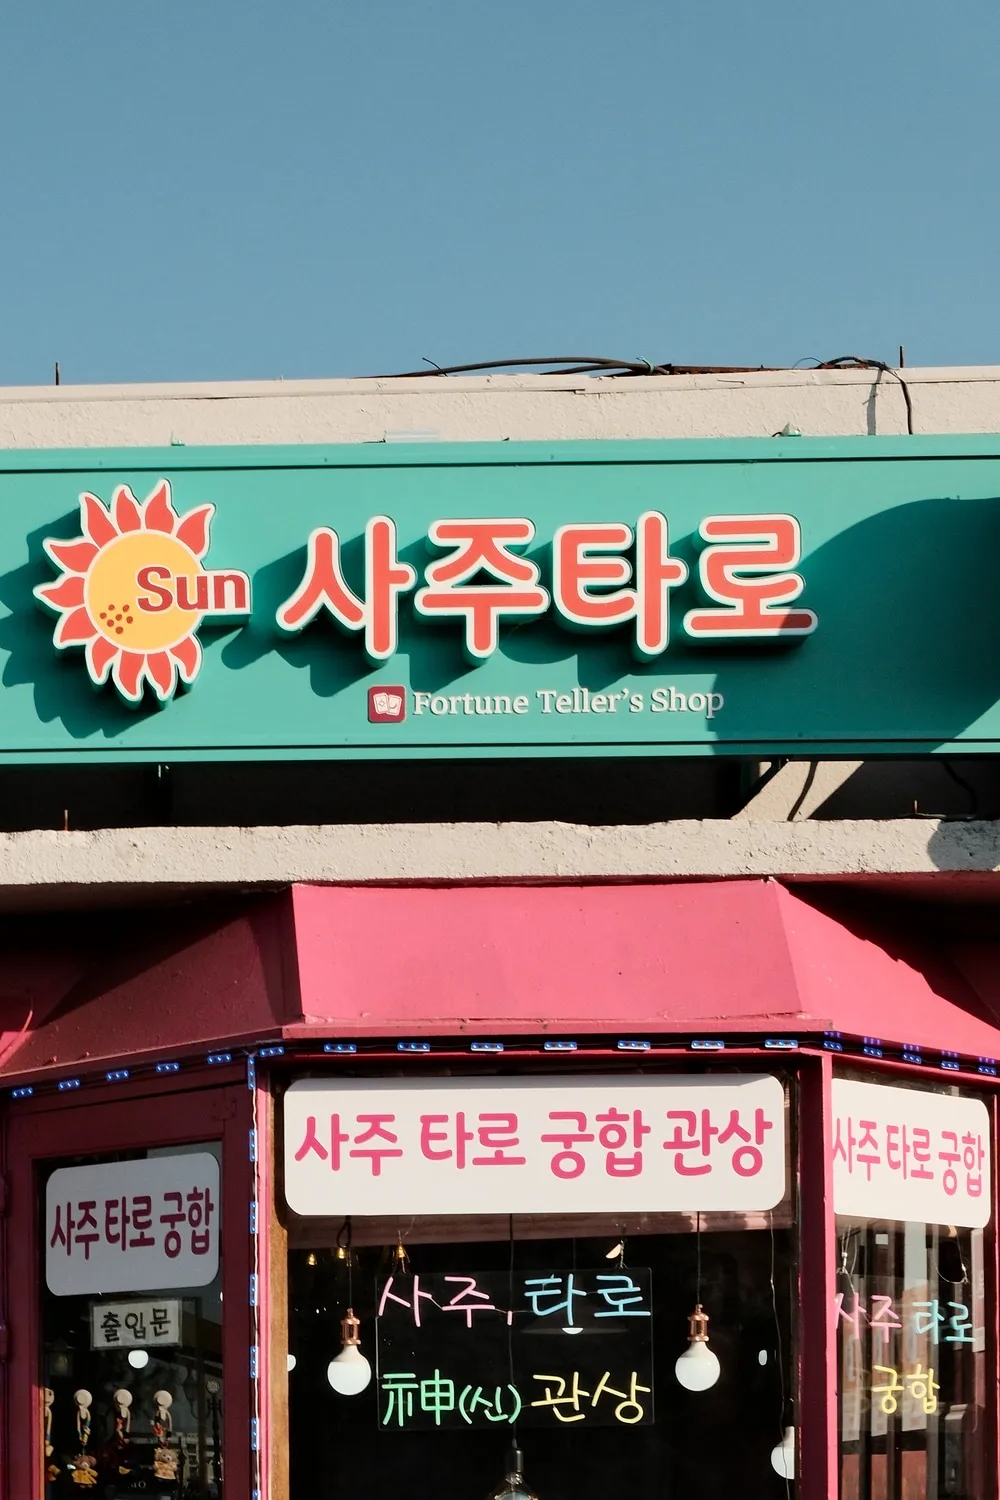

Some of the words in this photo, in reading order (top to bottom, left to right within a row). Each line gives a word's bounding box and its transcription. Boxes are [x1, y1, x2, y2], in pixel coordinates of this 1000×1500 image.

[136, 566, 248, 612] Sun
[276, 510, 819, 664] 사주타로
[413, 691, 530, 716] Fortune
[536, 687, 644, 714] Teller's
[650, 685, 725, 719] Shop
[294, 1113, 403, 1177] 사주
[419, 1111, 526, 1169] 타로
[540, 1107, 651, 1180] 궁합
[663, 1108, 773, 1178] 관상
[833, 1116, 881, 1182] 사주
[886, 1123, 934, 1181] 타로
[938, 1129, 985, 1198] 궁합
[50, 1200, 100, 1260] 사주
[105, 1195, 155, 1252] 타로
[160, 1186, 214, 1259] 궁합
[100, 1307, 172, 1343] 출입문
[524, 1273, 651, 1326] 타로
[835, 1292, 903, 1344] 사주
[912, 1299, 976, 1346] 타로
[530, 1371, 651, 1424] 관상
[871, 1363, 940, 1415] 궁합
